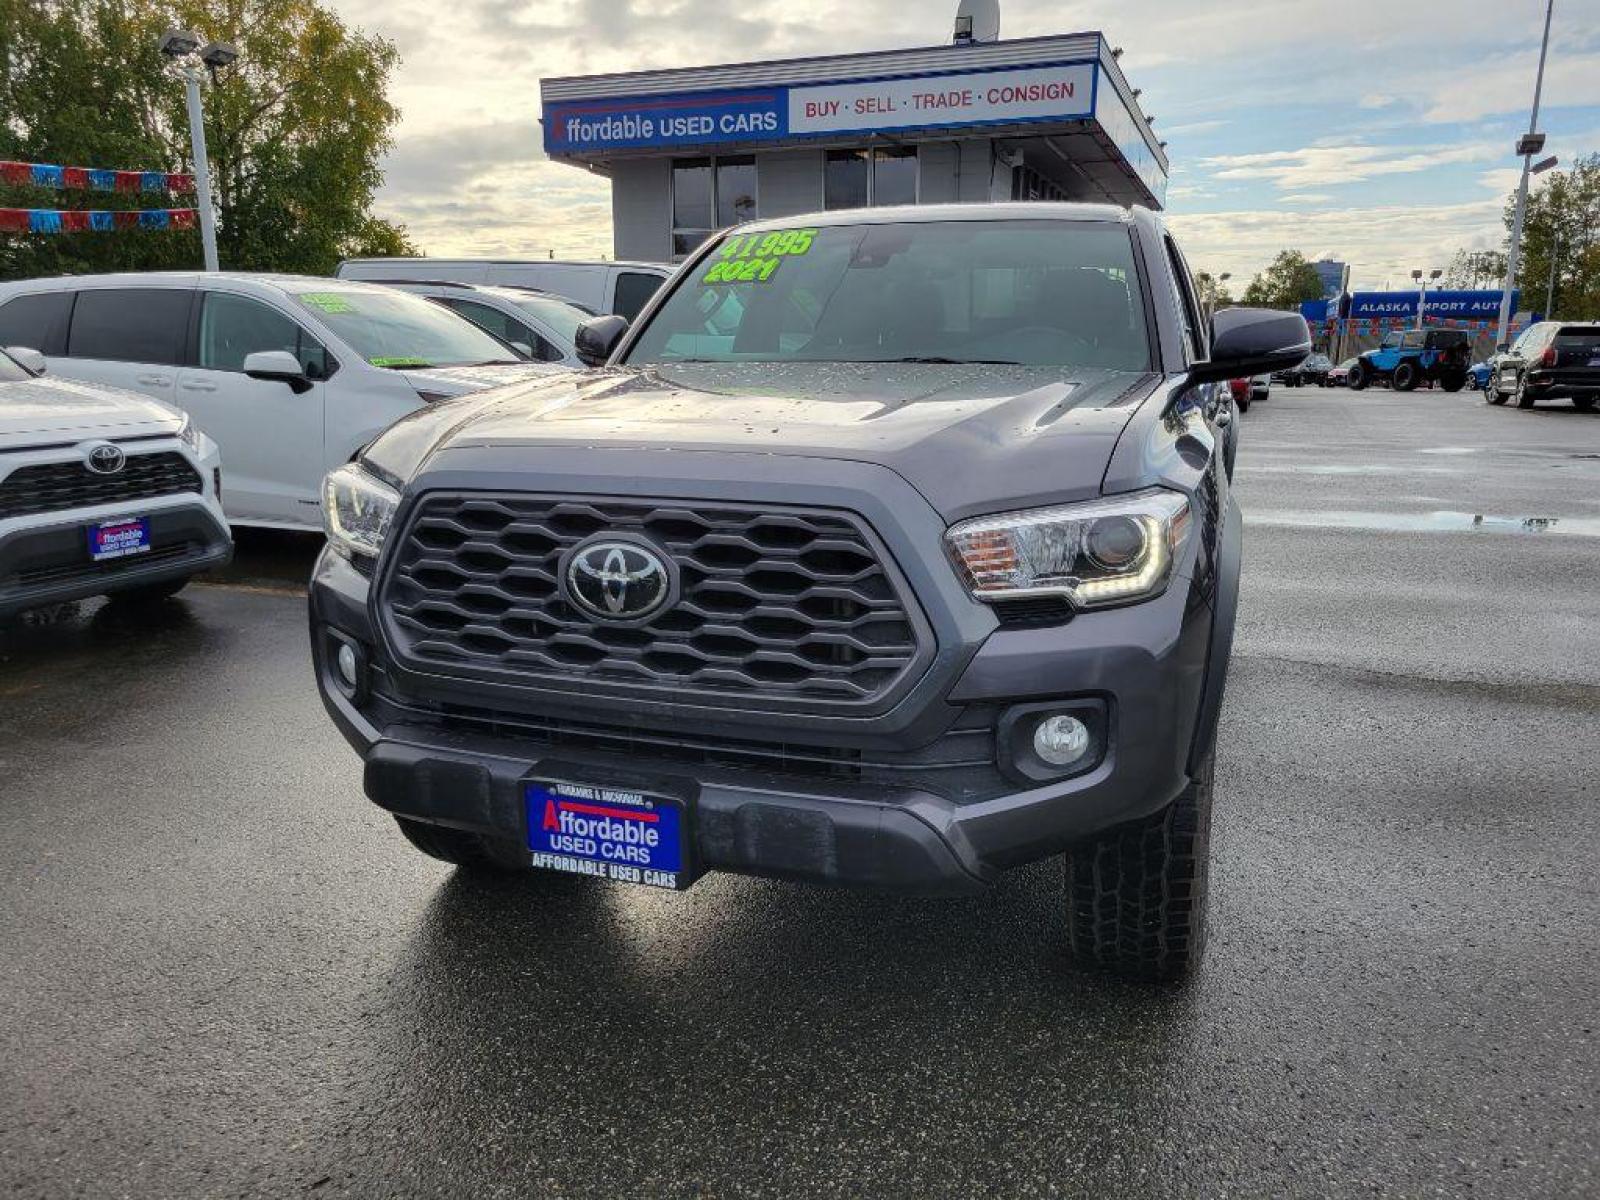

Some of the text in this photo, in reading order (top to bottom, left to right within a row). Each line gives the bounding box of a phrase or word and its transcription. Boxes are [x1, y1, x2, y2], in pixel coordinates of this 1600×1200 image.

[805, 82, 1075, 118] BUY SELL TRADE CONSIGN
[660, 115, 714, 137] USED
[719, 112, 778, 132] CARS
[720, 229, 819, 258] 41995
[703, 258, 780, 283] 2021
[1359, 302, 1410, 312] ALASKA
[1471, 302, 1503, 311] AUT
[543, 800, 659, 847] Affordable
[550, 834, 651, 864] USED CARS
[532, 853, 676, 888] AFFORDABLE USED CARS
